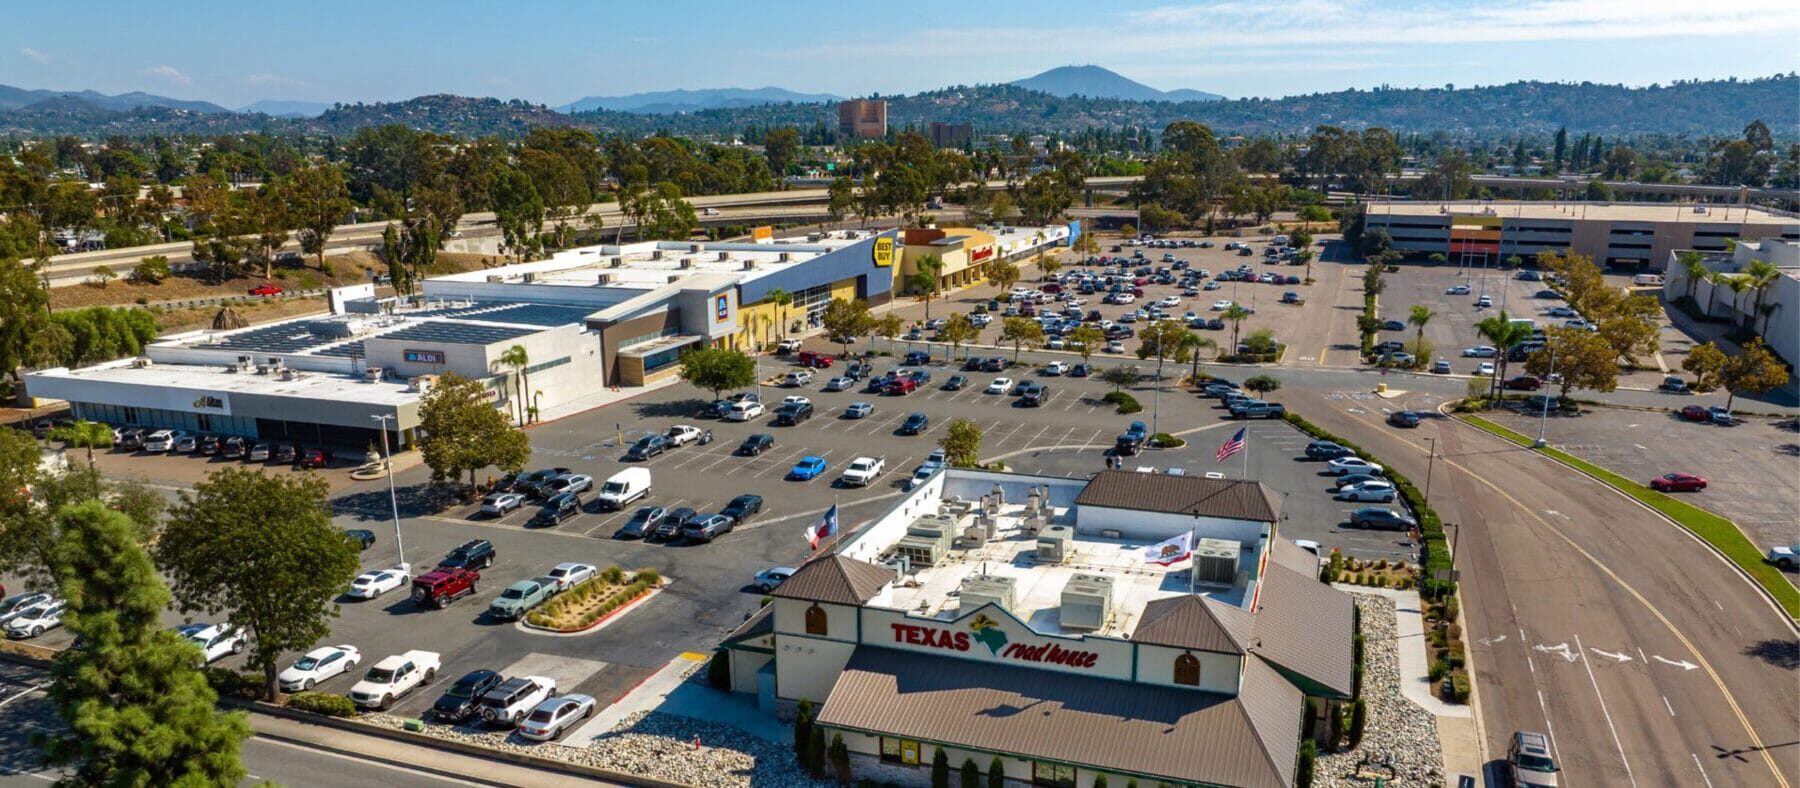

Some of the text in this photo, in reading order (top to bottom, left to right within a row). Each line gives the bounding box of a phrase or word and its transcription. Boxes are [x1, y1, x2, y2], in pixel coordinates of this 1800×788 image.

[877, 242, 891, 250] BEST
[877, 252, 890, 260] BUY
[417, 353, 436, 361] ALDI
[891, 623, 970, 651] TEXAS
